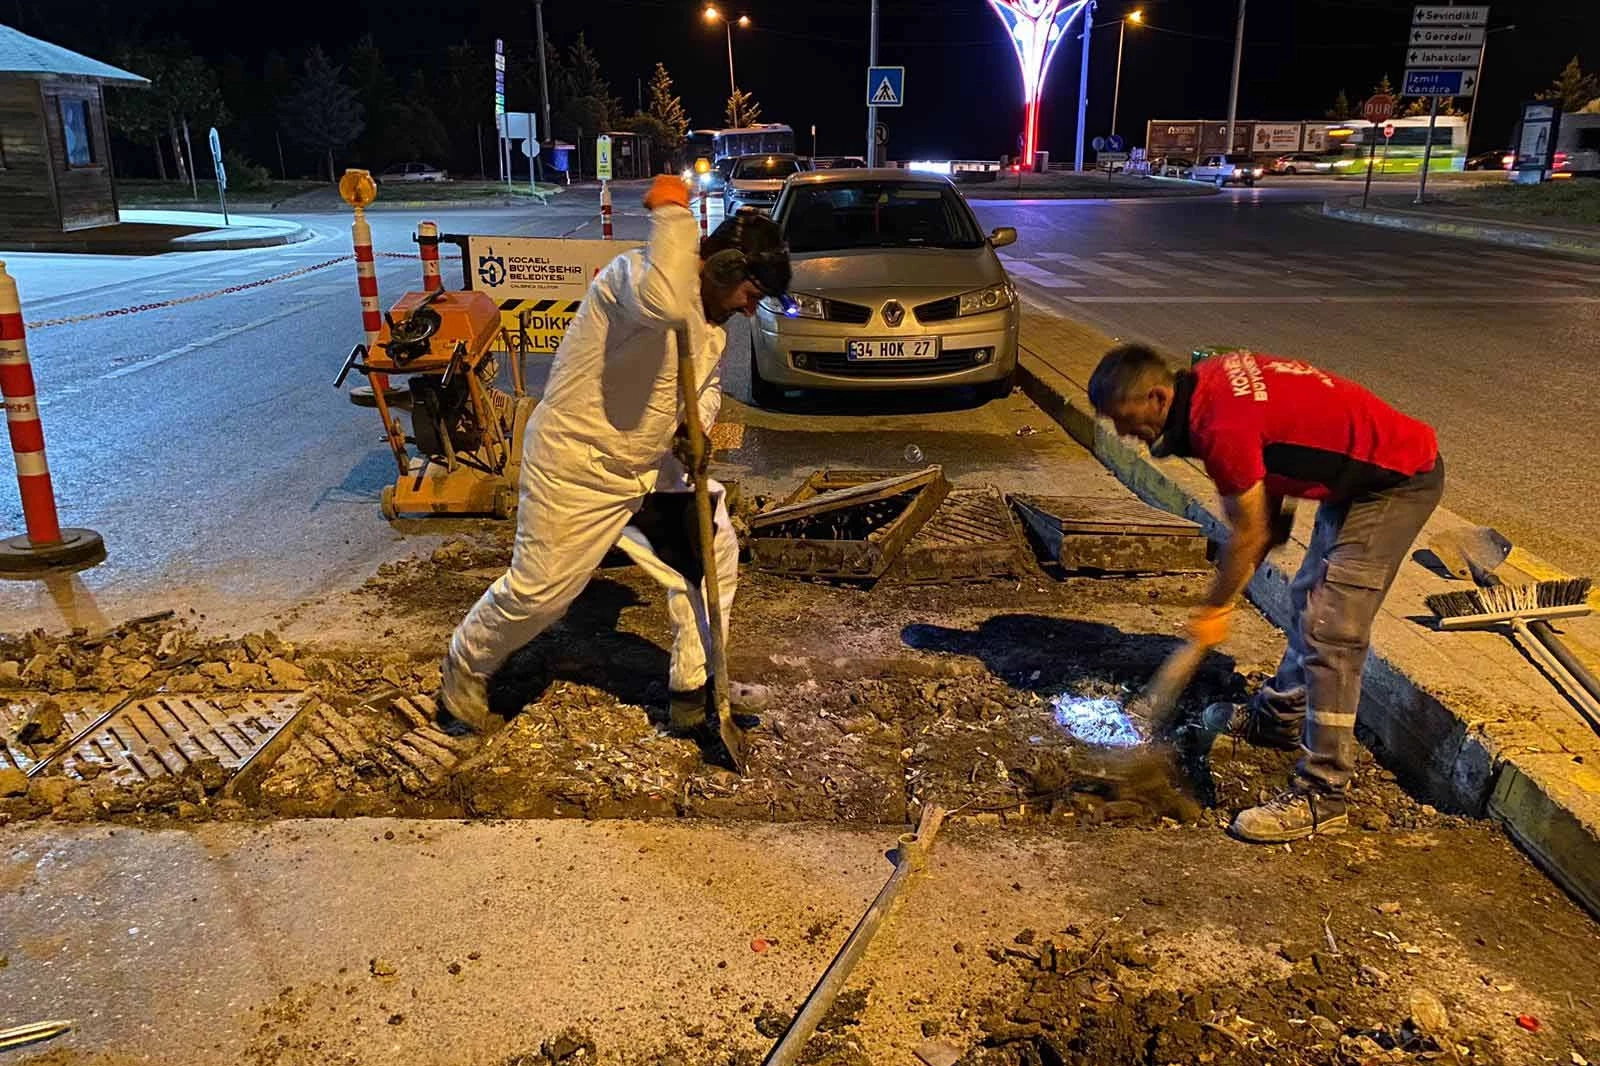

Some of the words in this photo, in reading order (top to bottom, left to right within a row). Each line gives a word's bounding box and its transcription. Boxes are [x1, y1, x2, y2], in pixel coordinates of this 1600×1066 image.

[1426, 10, 1479, 20] Sevindikli
[1425, 31, 1472, 41] Geredeli
[1366, 103, 1391, 115] DUR
[510, 334, 563, 352] ÇALIŞ
[856, 342, 873, 357] 34
[880, 342, 905, 357] HOK
[914, 341, 931, 356] 27
